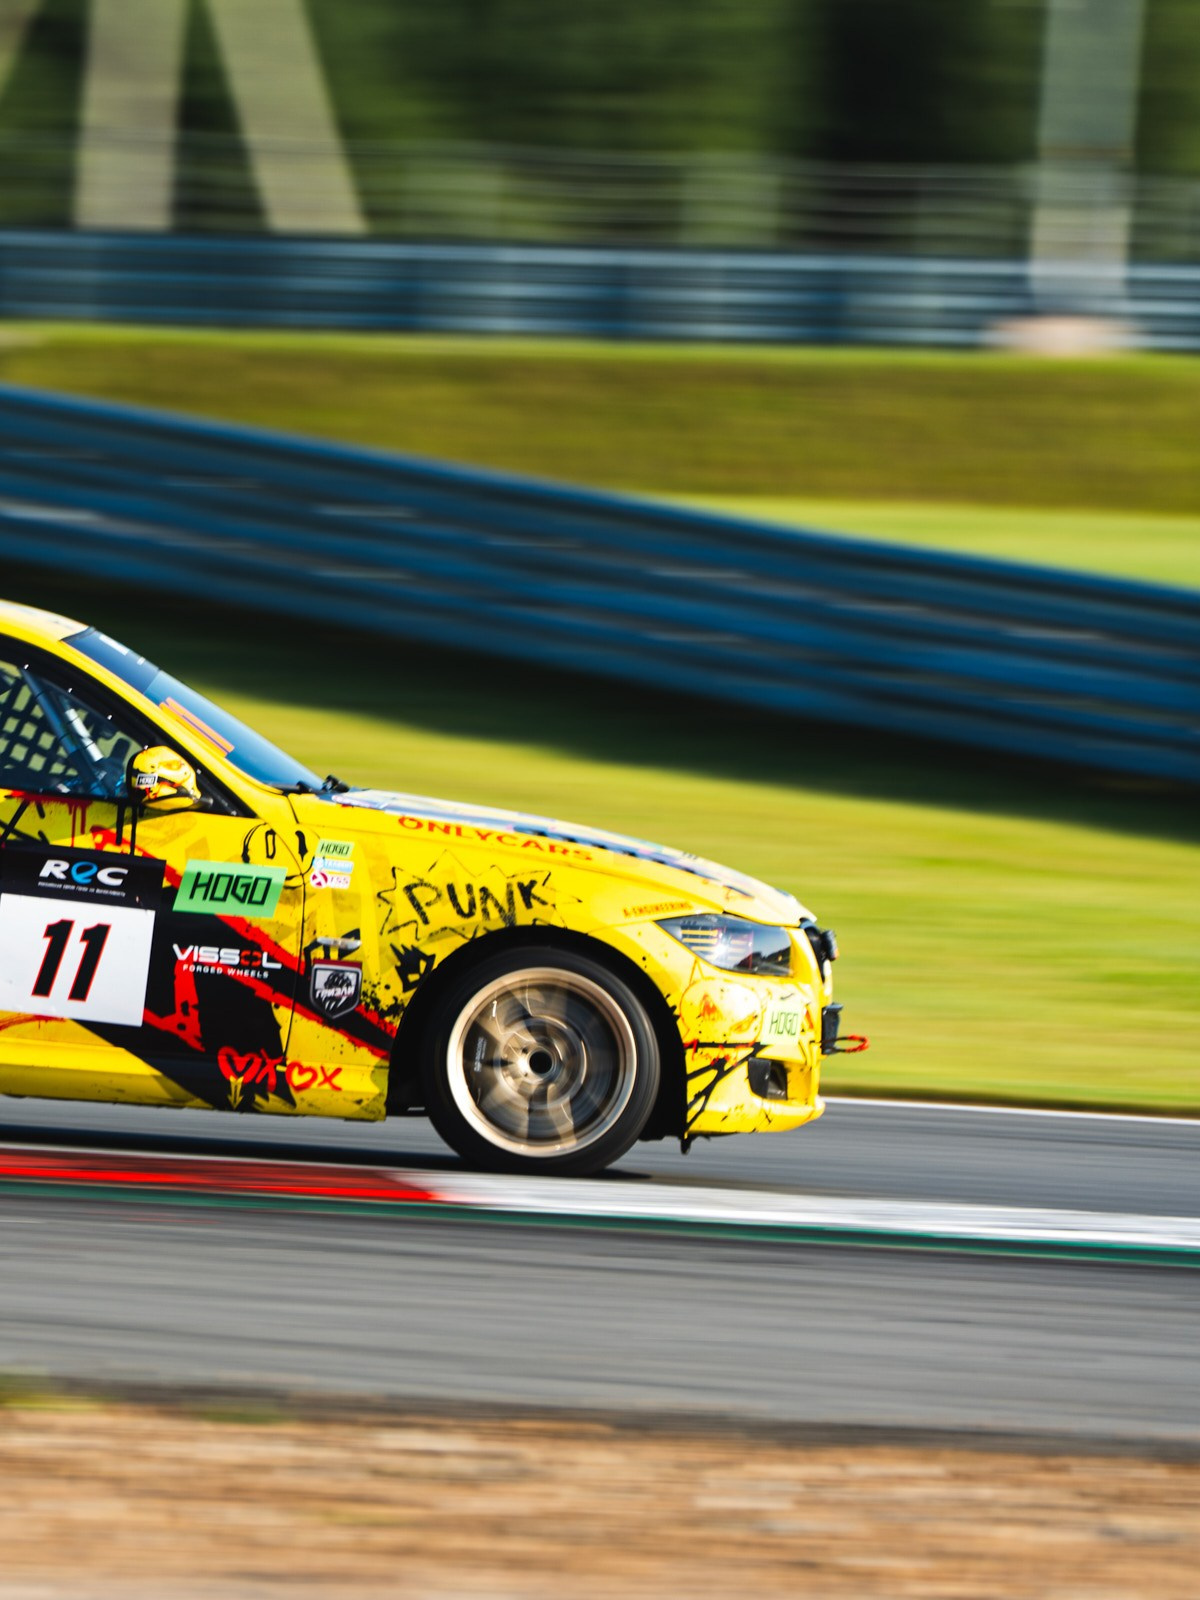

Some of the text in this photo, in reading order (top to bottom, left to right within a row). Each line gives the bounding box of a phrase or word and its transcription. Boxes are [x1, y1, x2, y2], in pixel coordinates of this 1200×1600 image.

[398, 816, 593, 862] ONLYCARS
[189, 871, 273, 906] HOGO
[403, 879, 550, 928] PUNK
[31, 919, 112, 1002] 11
[172, 943, 282, 969] VISSOL
[182, 963, 269, 979] FORGED WHEELS
